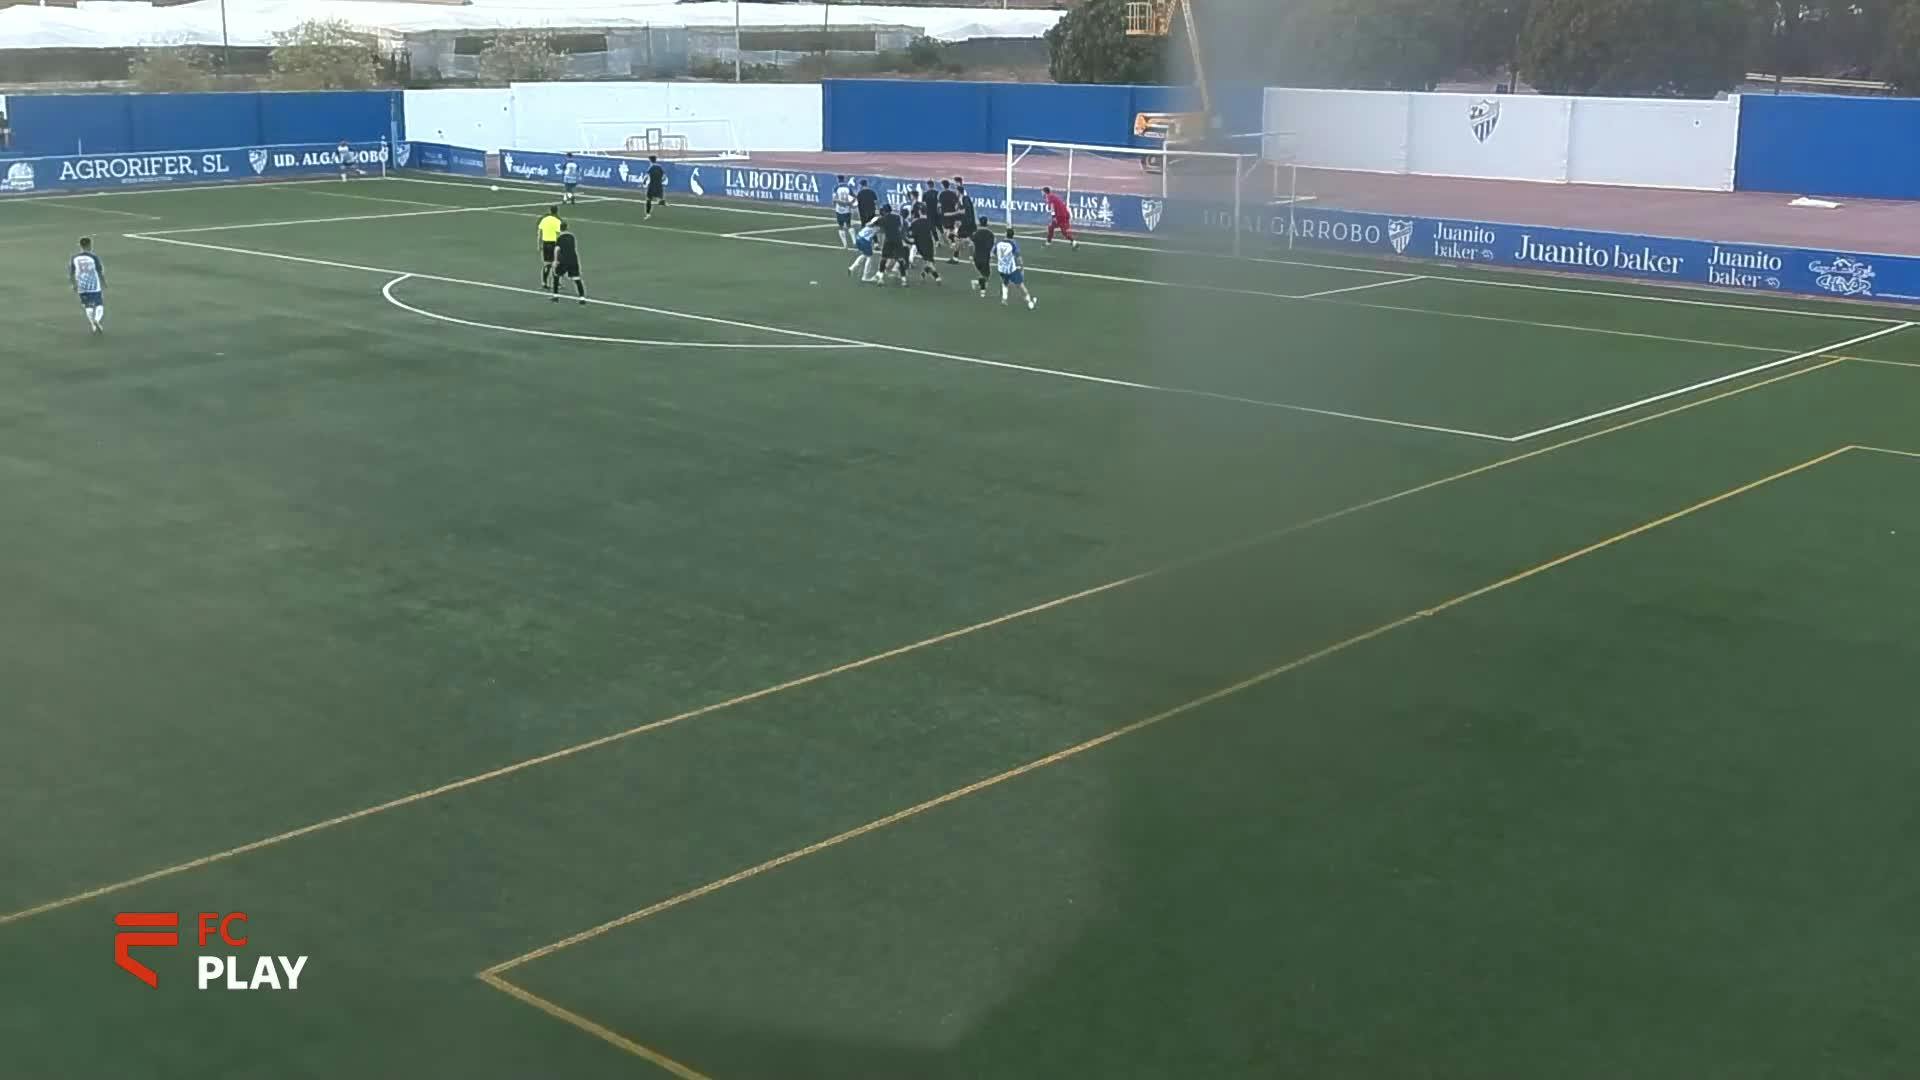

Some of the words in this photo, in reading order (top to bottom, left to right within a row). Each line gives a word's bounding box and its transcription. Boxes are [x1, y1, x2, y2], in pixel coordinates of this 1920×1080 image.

[59, 156, 199, 181] AGRORIFER,
[202, 154, 230, 174] SL
[273, 153, 300, 168] UD.
[725, 169, 746, 189] LA
[752, 171, 819, 194] BODEGA
[1010, 200, 1053, 213] EVENTO
[1080, 195, 1098, 209] LAS
[1433, 221, 1496, 244] Juanito
[1434, 241, 1479, 260] baker
[1514, 234, 1609, 267] Juanito
[1614, 244, 1684, 274] baker
[1707, 245, 1782, 271] Juanito
[1708, 266, 1762, 288] baker
